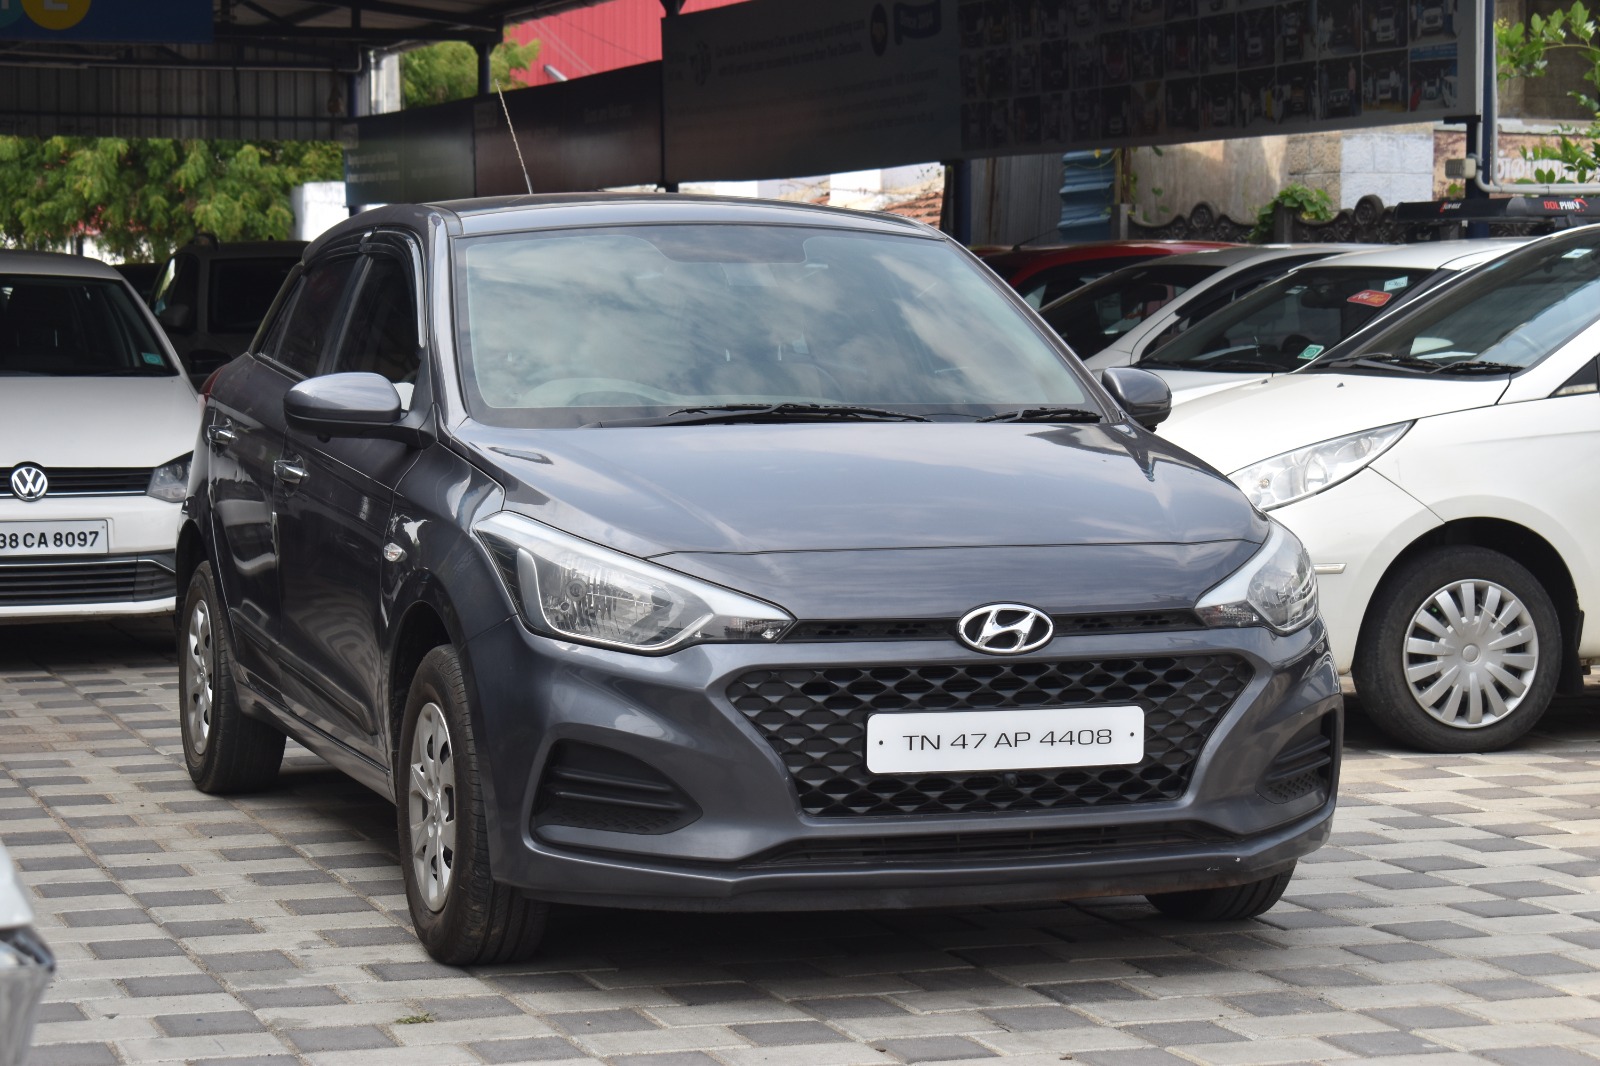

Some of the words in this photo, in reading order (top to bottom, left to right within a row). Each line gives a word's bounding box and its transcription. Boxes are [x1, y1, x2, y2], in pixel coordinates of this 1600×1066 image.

[1543, 200, 1581, 211] DOLPHIN
[23, 531, 49, 548] CA
[53, 530, 99, 547] 8097
[902, 734, 941, 751] TN
[950, 733, 988, 750] 47
[993, 731, 1032, 749] AP
[1039, 728, 1113, 747] 4408
